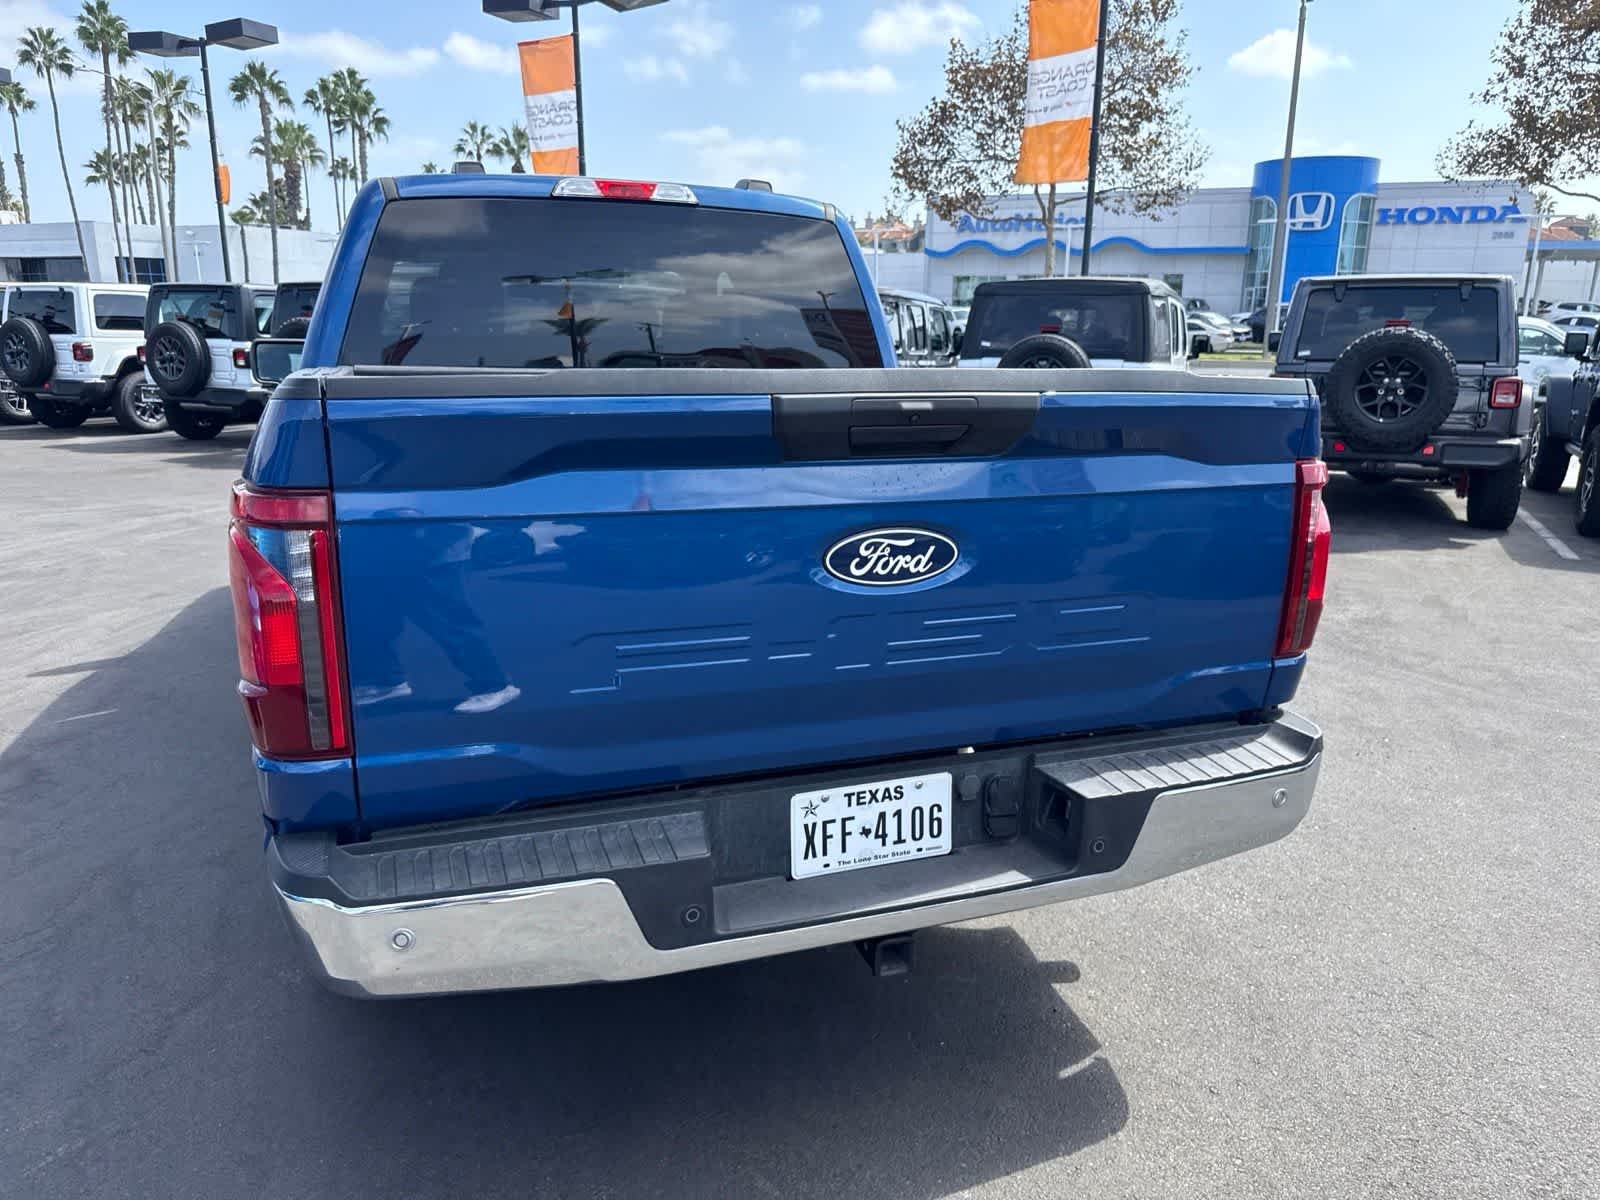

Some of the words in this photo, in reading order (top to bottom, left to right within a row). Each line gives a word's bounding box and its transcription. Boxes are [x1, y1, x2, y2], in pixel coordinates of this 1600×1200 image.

[1375, 205, 1527, 225] HONDA
[850, 538, 936, 577] Ford
[843, 785, 904, 808] TEXAS
[803, 816, 855, 860] XFF
[874, 803, 943, 847] 4106
[854, 856, 872, 864] Lone
[874, 853, 889, 861] Star
[891, 849, 911, 858] State
